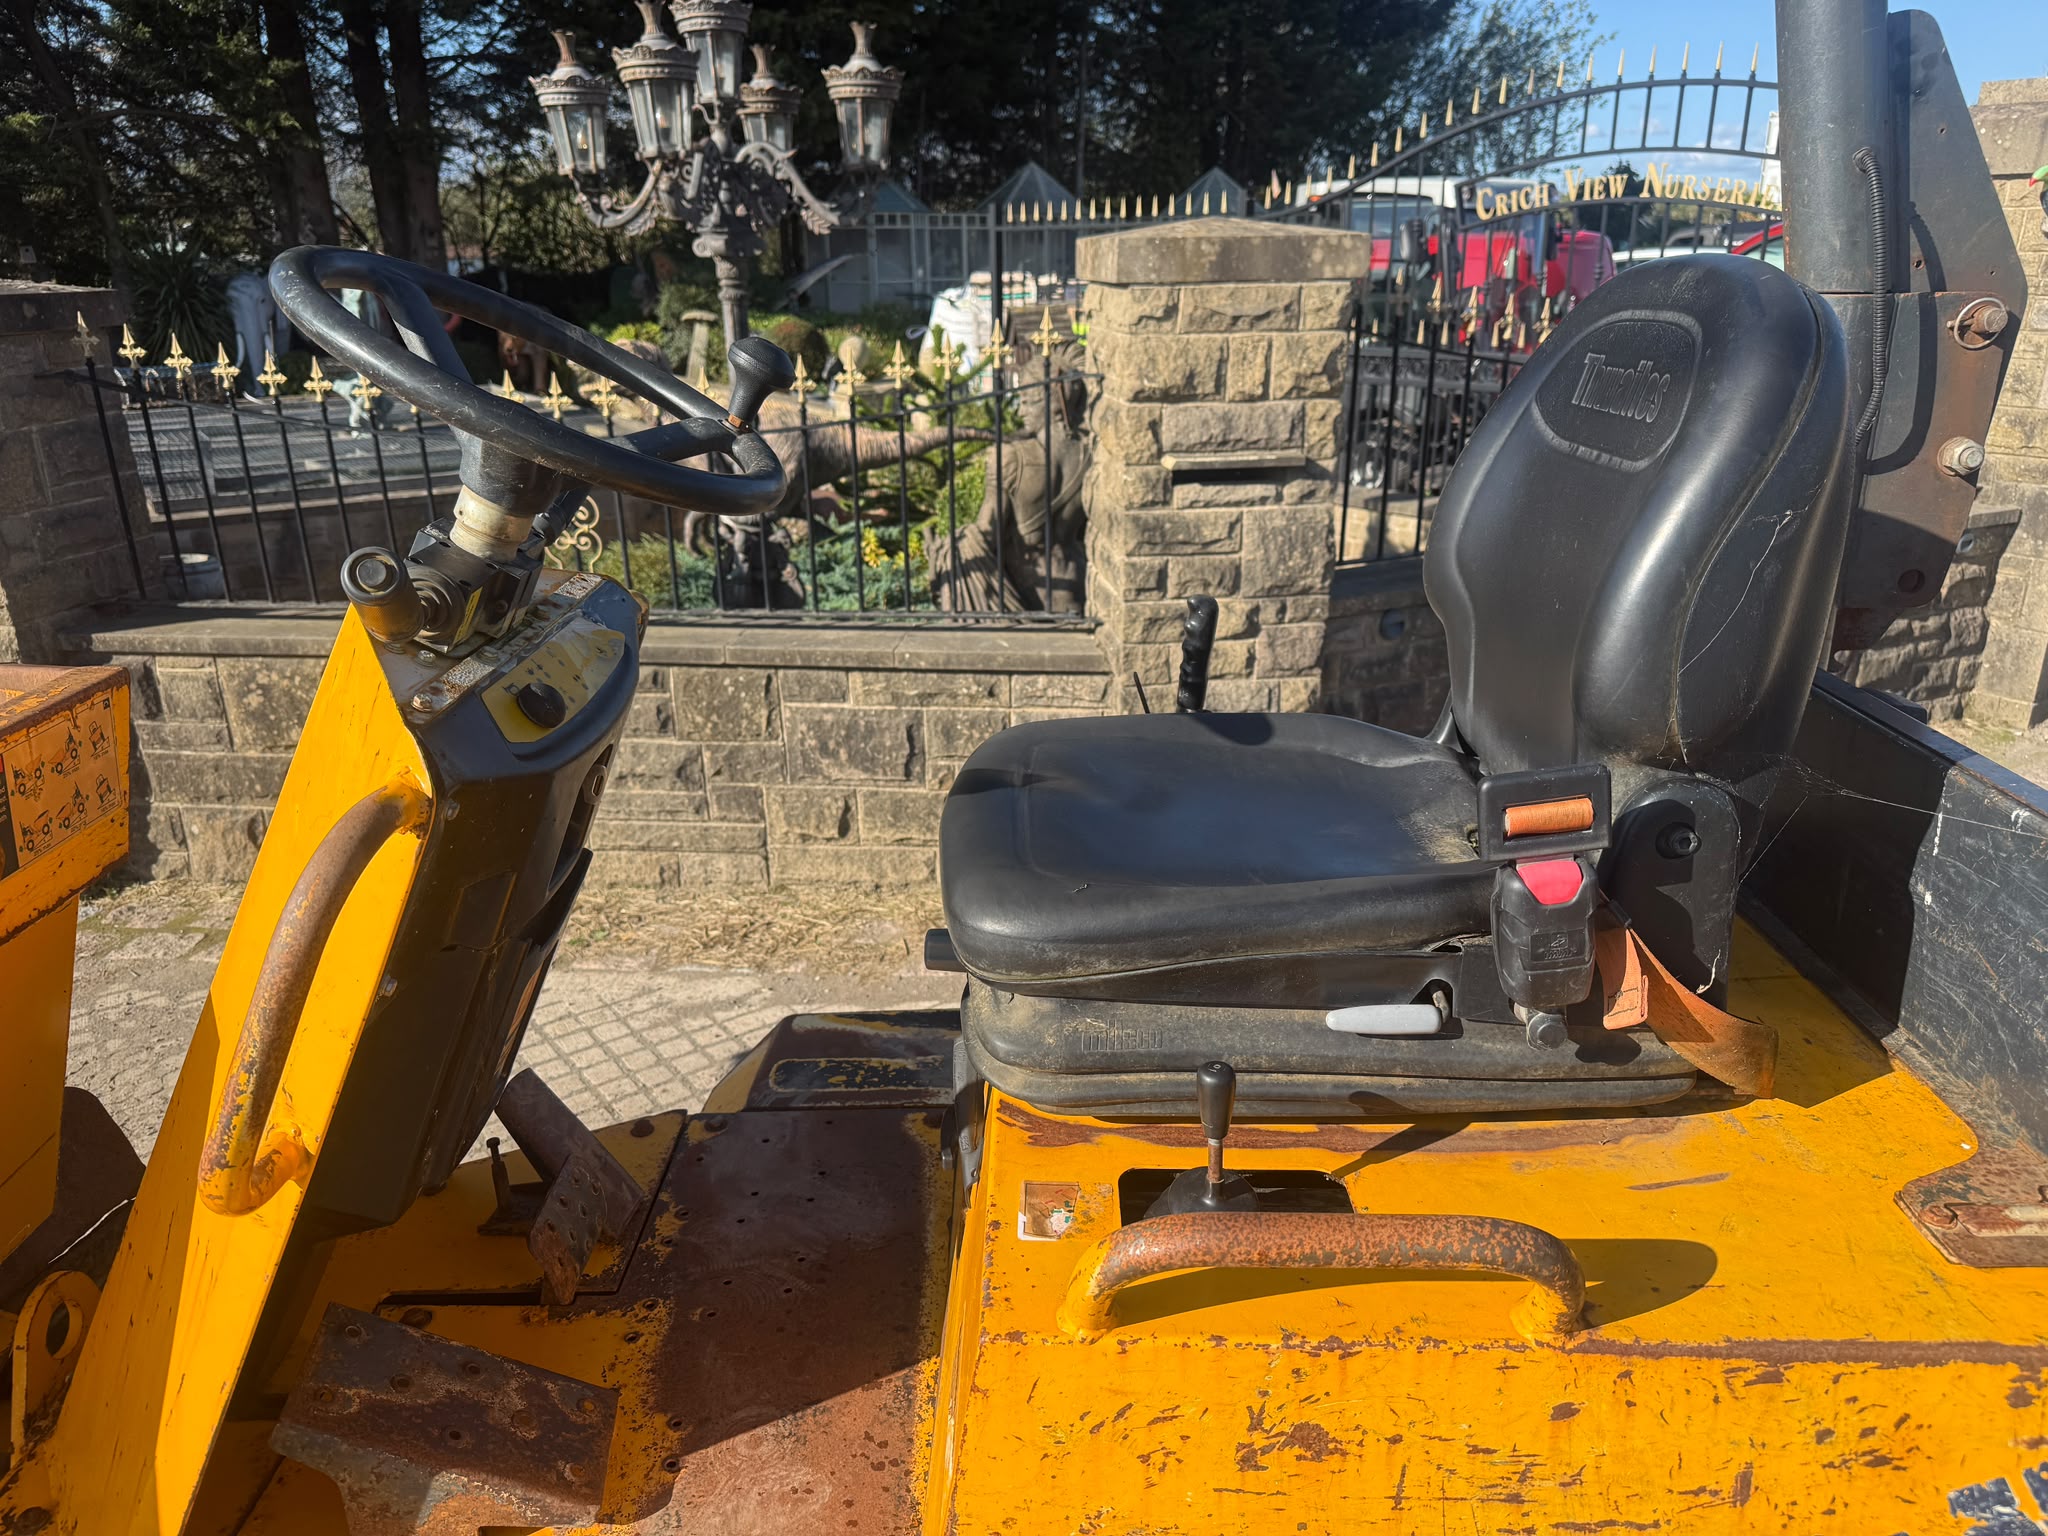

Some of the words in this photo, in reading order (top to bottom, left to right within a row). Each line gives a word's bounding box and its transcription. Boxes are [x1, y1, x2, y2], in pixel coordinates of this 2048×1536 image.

[1475, 182, 1550, 221] CRICH
[1564, 167, 1630, 203] VIEW
[1571, 352, 1671, 423] Thwaites
